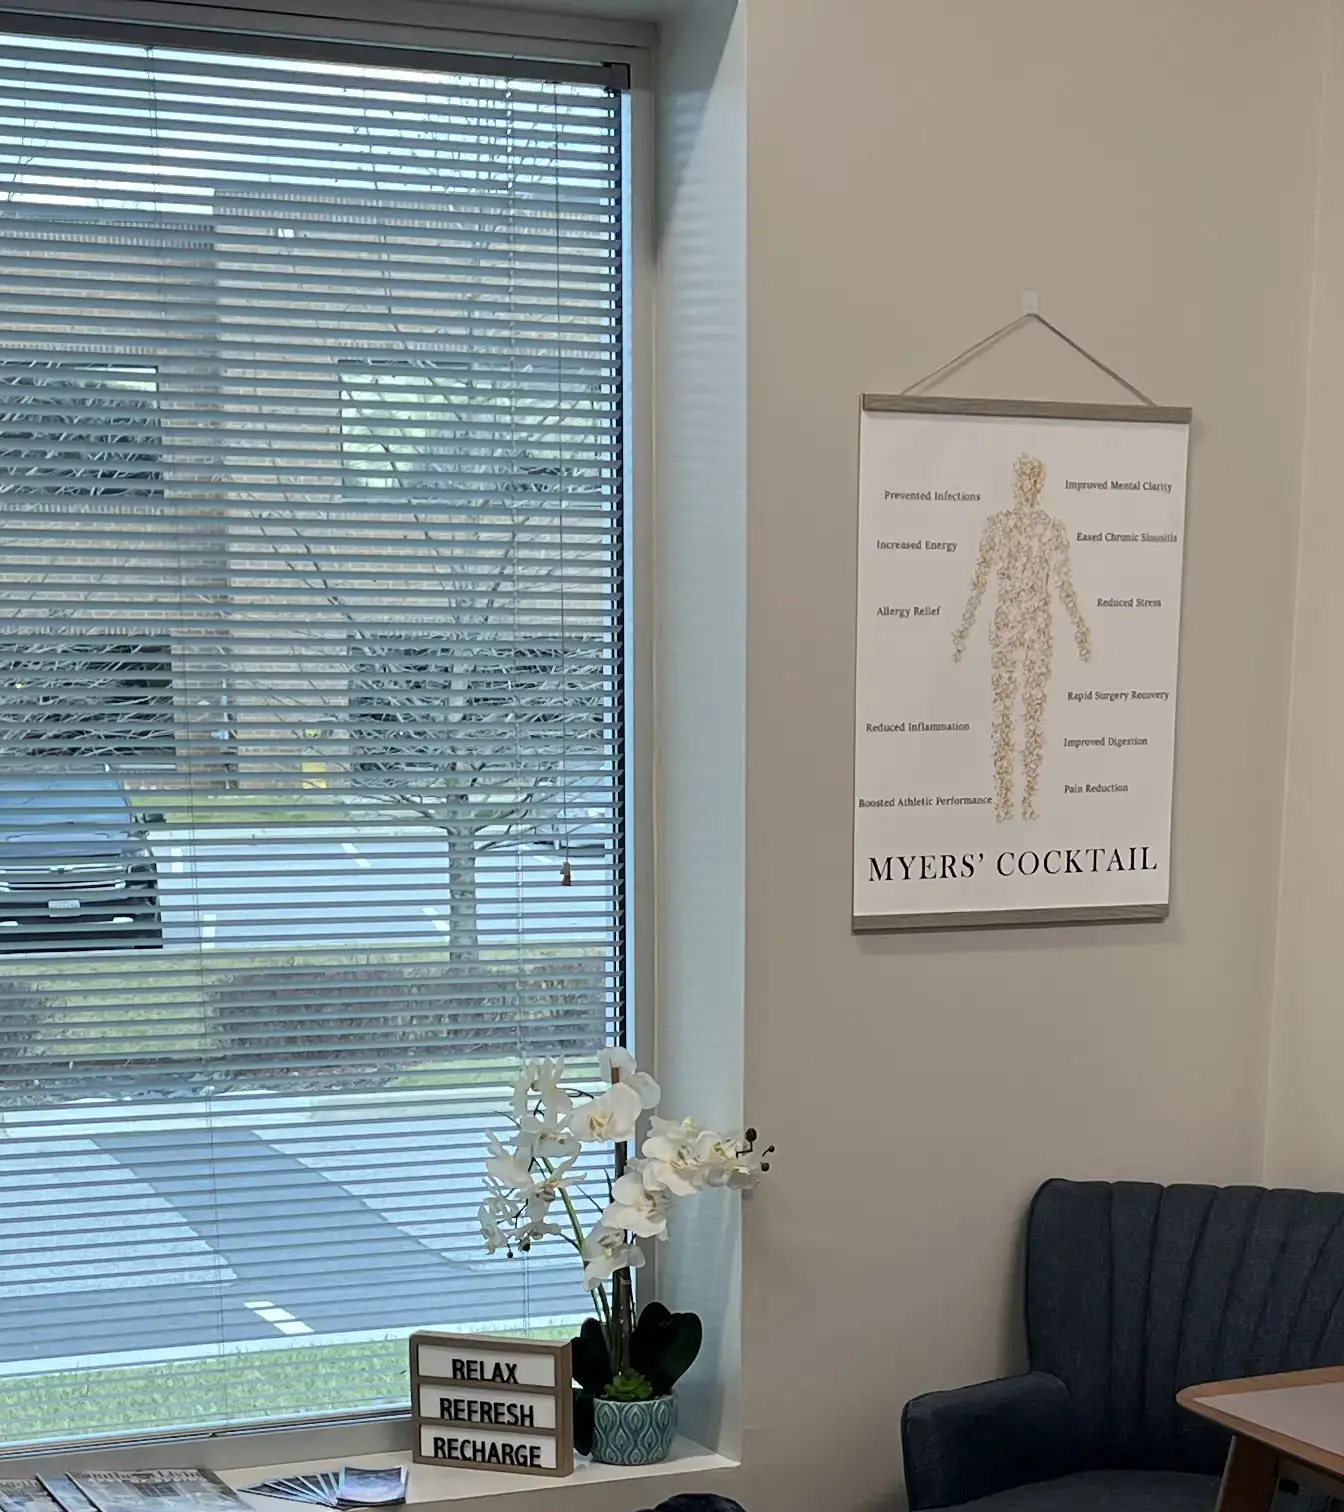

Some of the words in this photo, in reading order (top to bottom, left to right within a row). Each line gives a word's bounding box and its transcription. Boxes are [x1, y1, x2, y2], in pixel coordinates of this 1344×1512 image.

[1065, 479, 1108, 491] Improved
[1110, 480, 1141, 491] Mental
[1142, 482, 1173, 492] Clarity
[884, 490, 932, 500] Prevented
[934, 490, 981, 501] Infections
[1076, 532, 1103, 542] Eased
[1105, 532, 1139, 543] Chronic
[876, 540, 922, 550] Increased
[925, 540, 958, 552] Energy
[1096, 597, 1133, 608] Reduced
[1136, 597, 1162, 608] Stress
[876, 606, 911, 618] Allergy
[913, 605, 941, 616] Relief
[1067, 691, 1093, 701] Rapid
[1094, 690, 1129, 701] Surgery
[1131, 690, 1170, 700] Recovery
[866, 722, 905, 732] Reduced
[908, 721, 970, 732] Inflammation
[1064, 737, 1105, 747] Improved
[1108, 736, 1148, 747] Digestion
[1064, 783, 1083, 793] Pain
[1086, 783, 1129, 793] Reduction
[859, 797, 895, 808] Boosted
[897, 796, 934, 807] Athletic
[936, 795, 993, 806] Performance
[996, 846, 1158, 877] COCKTAIL
[452, 1359, 518, 1384] RELAX
[440, 1398, 534, 1428] REFRESH
[434, 1437, 542, 1468] RECHARGE
